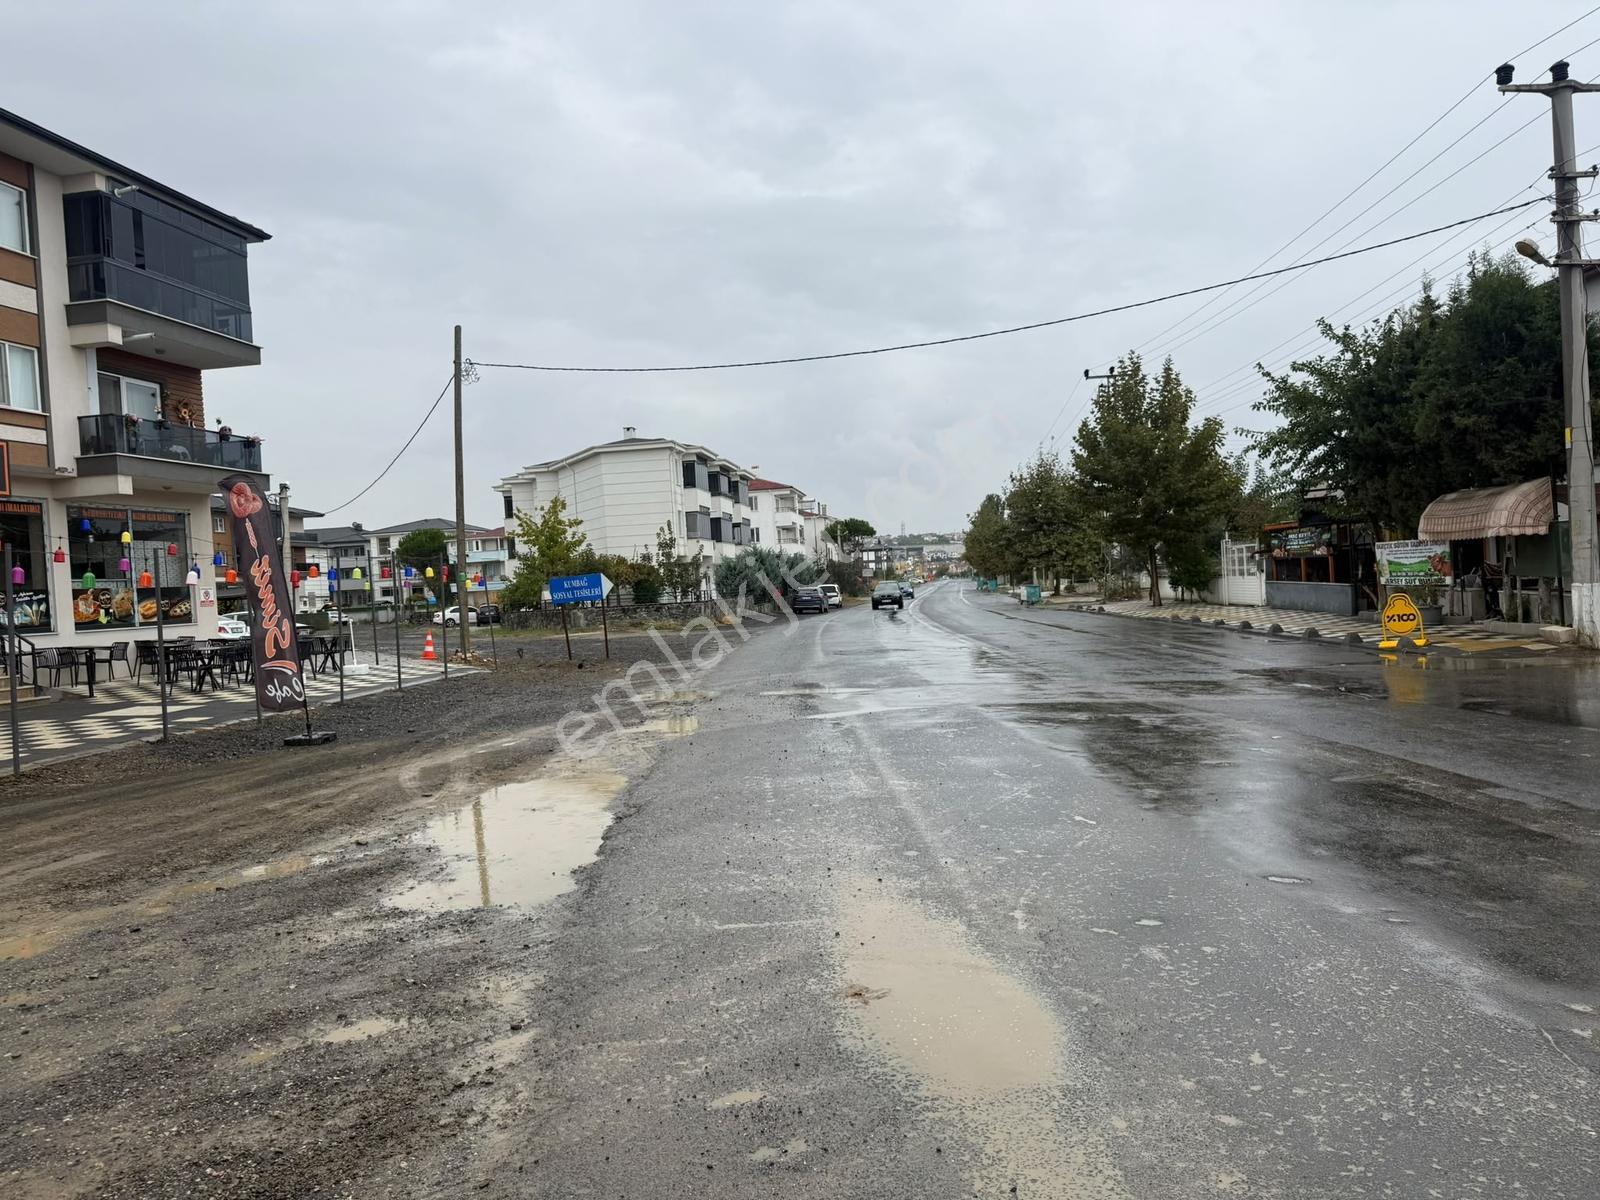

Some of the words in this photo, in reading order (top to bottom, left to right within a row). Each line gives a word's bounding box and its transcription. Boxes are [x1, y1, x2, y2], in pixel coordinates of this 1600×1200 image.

[563, 576, 588, 588] KUMBAĞ
[552, 590, 574, 600] SOSYAL
[574, 586, 602, 598] TESİSLERİ
